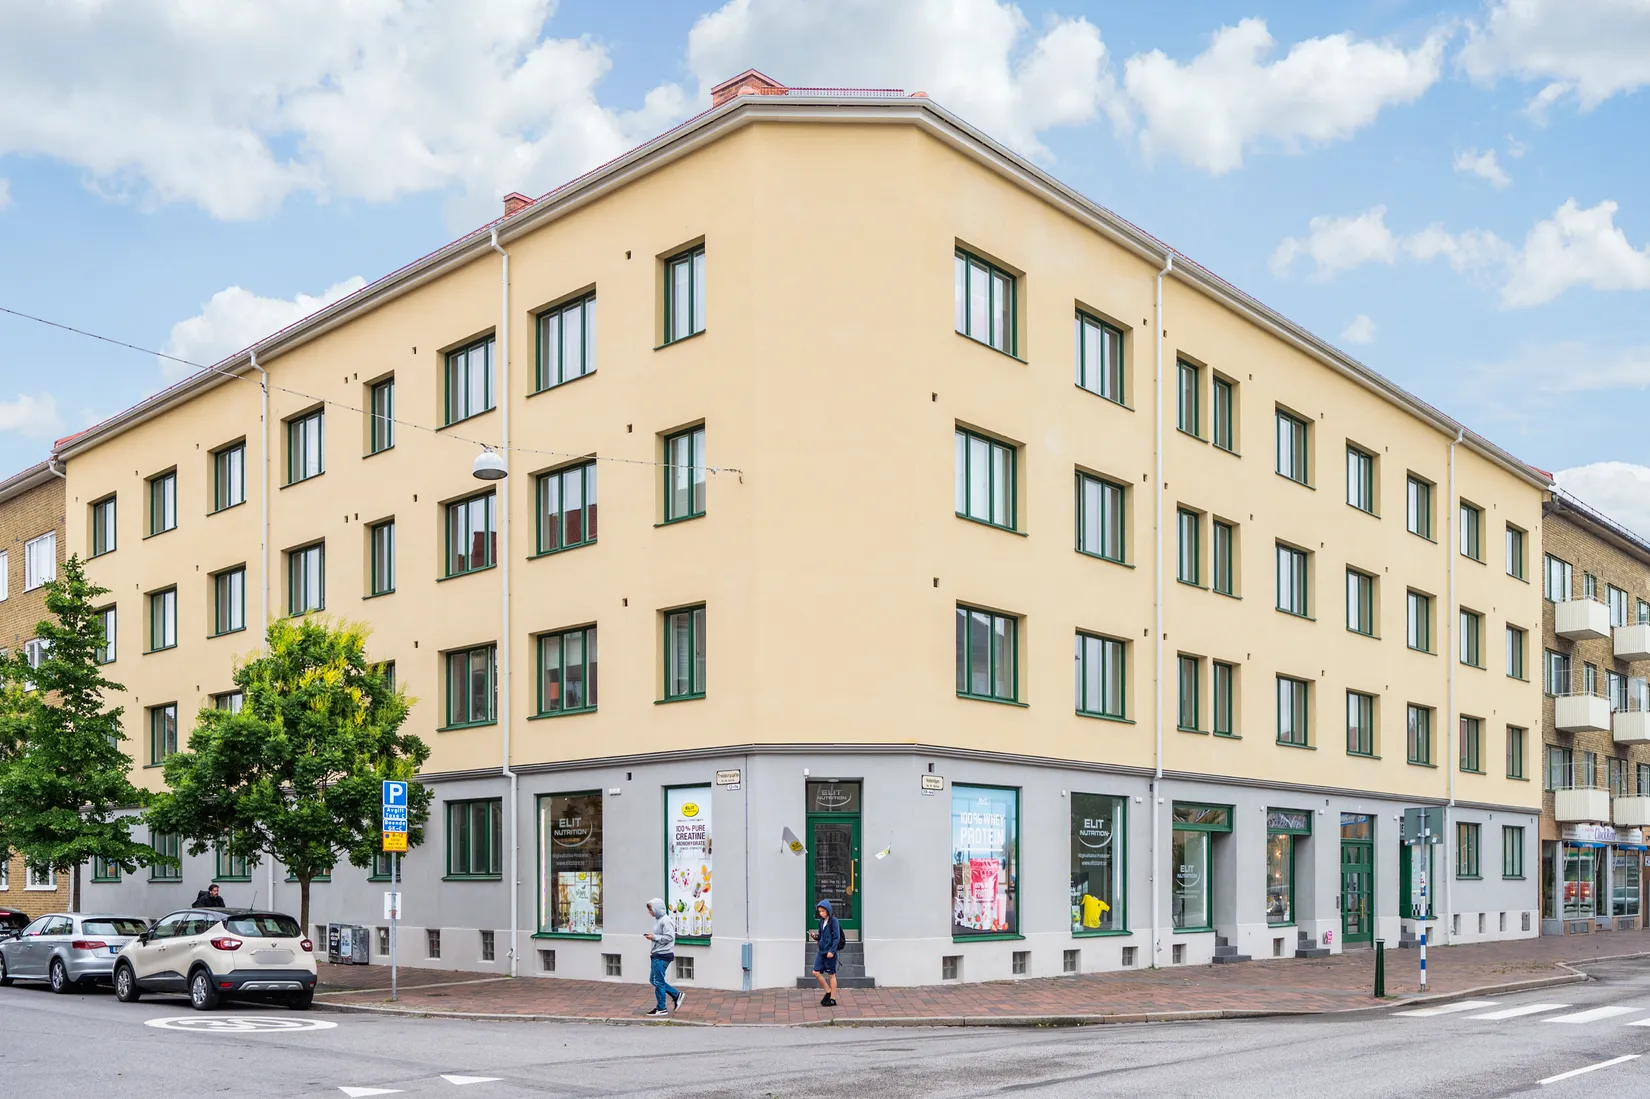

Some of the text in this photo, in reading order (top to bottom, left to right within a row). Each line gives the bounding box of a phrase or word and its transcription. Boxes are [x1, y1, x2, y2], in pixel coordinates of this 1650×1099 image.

[390, 784, 403, 803] P
[558, 817, 582, 828] ELIT
[961, 812, 1004, 826] 100% WHEY
[1084, 818, 1105, 829] ELIT
[553, 828, 587, 836] NUTRITION
[675, 824, 706, 833] 100% PURE
[1079, 829, 1109, 837] NUTRITION
[675, 832, 706, 841] CREATINE
[961, 828, 1004, 845] PROTEIN
[1180, 864, 1195, 873] ELIT
